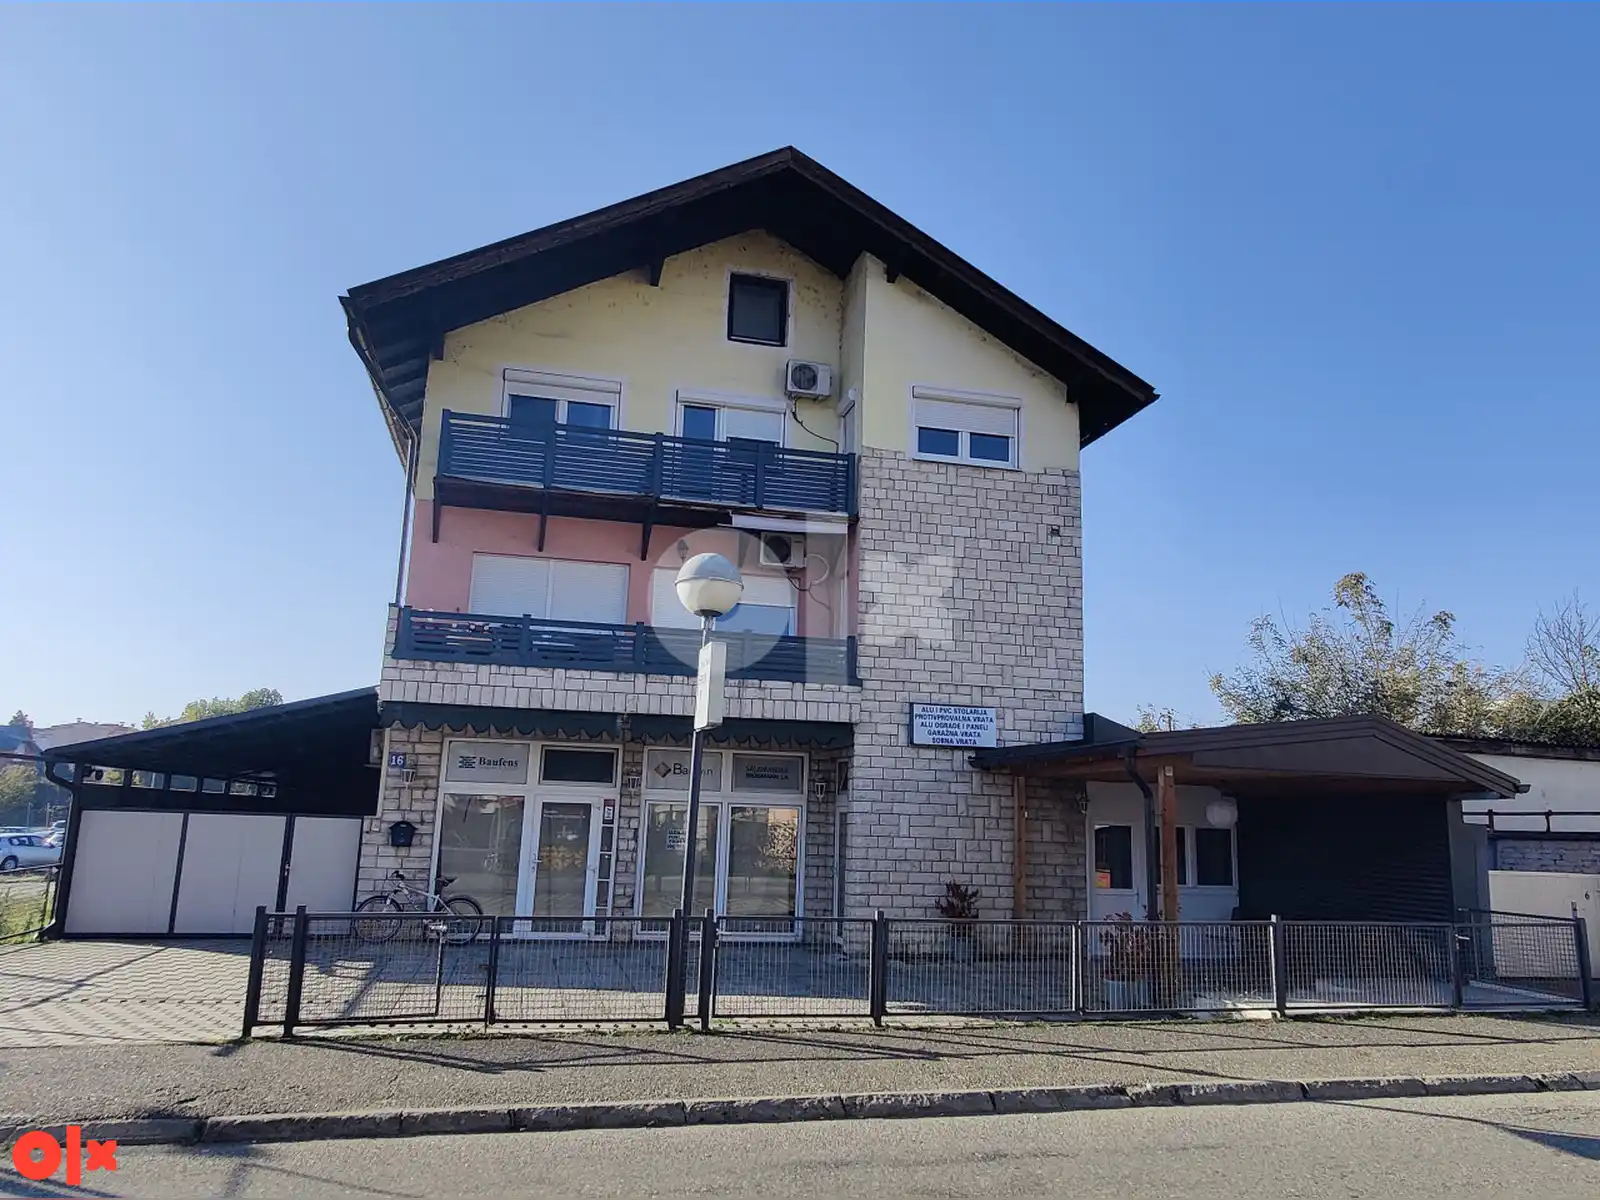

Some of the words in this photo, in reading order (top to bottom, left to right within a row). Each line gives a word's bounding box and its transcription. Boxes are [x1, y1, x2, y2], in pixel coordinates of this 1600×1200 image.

[953, 708, 988, 716] STOLARIJA
[914, 713, 972, 722] PROTIVPROVALNA
[965, 723, 989, 731] PANELI
[390, 755, 404, 766] 16
[478, 757, 519, 768] Baufens
